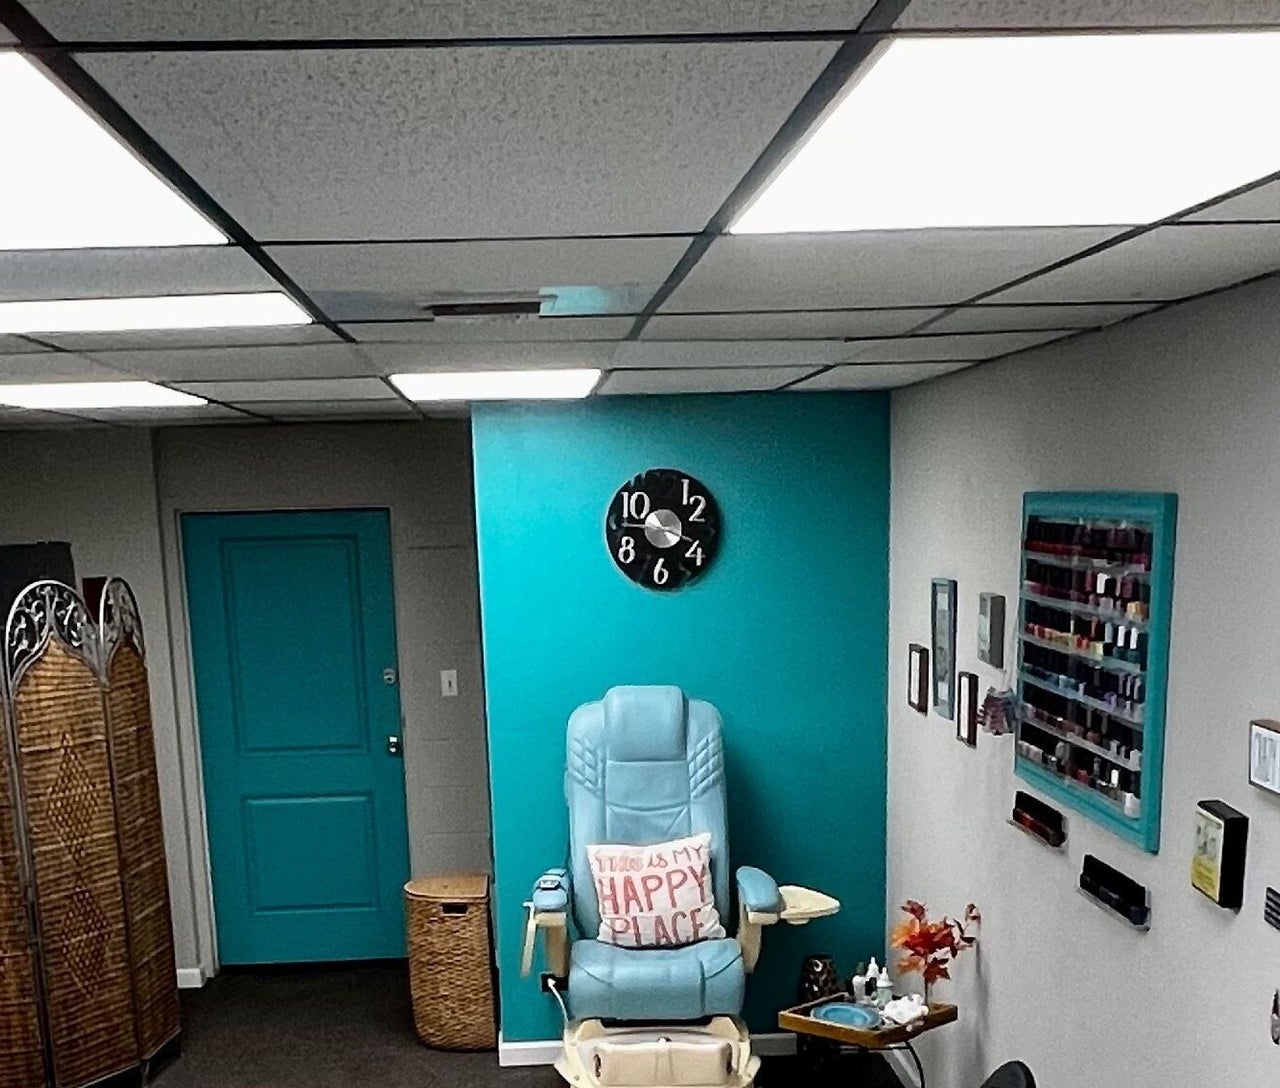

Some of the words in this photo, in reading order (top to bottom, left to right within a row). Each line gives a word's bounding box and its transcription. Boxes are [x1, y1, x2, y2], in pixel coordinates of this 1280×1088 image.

[621, 491, 651, 519] 10
[618, 536, 636, 564] 8
[684, 539, 706, 566] 4
[653, 557, 669, 585] 6
[672, 844, 704, 864] MY
[598, 863, 707, 915] HAPPY
[604, 908, 706, 946] PLACE
